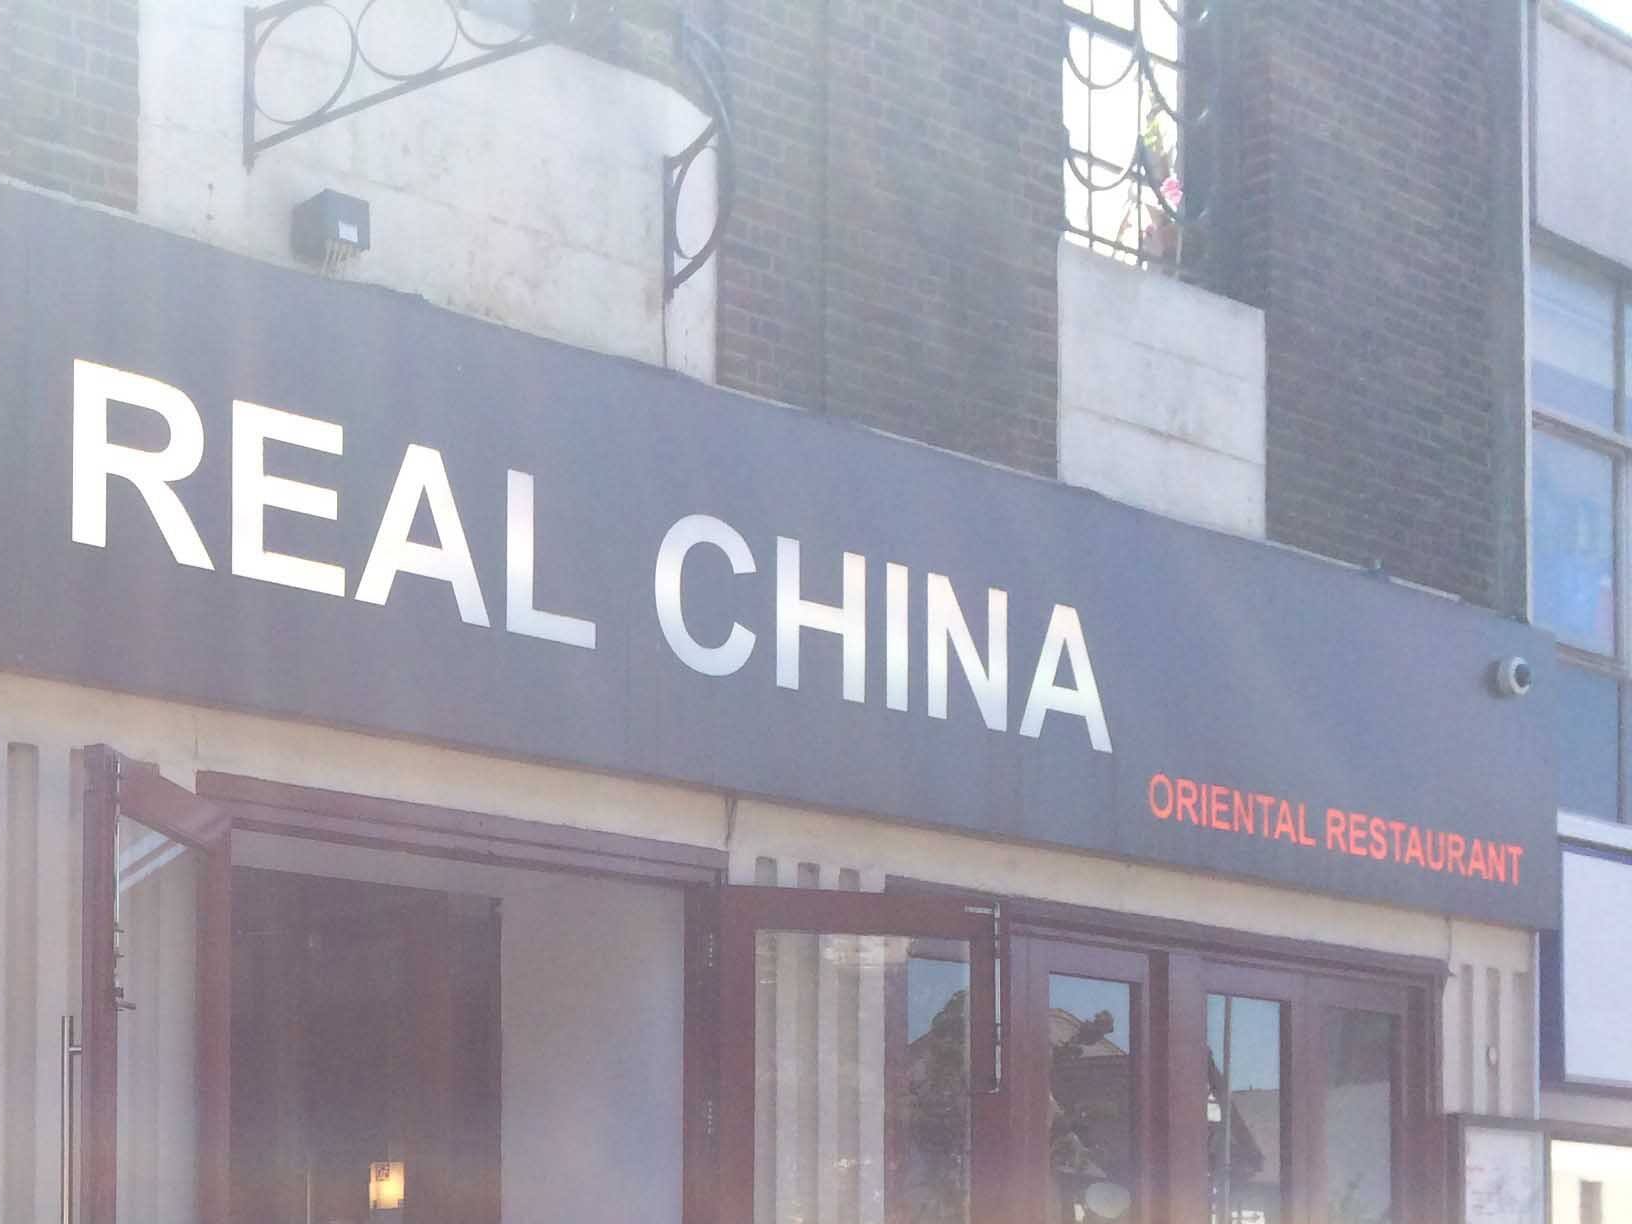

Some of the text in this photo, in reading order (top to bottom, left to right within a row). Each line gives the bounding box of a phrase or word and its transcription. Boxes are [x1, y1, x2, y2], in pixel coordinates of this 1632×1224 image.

[71, 358, 597, 650] REAL
[654, 513, 1113, 754] CHINA
[1147, 771, 1523, 886] ORIENTAL RESTAURANT
